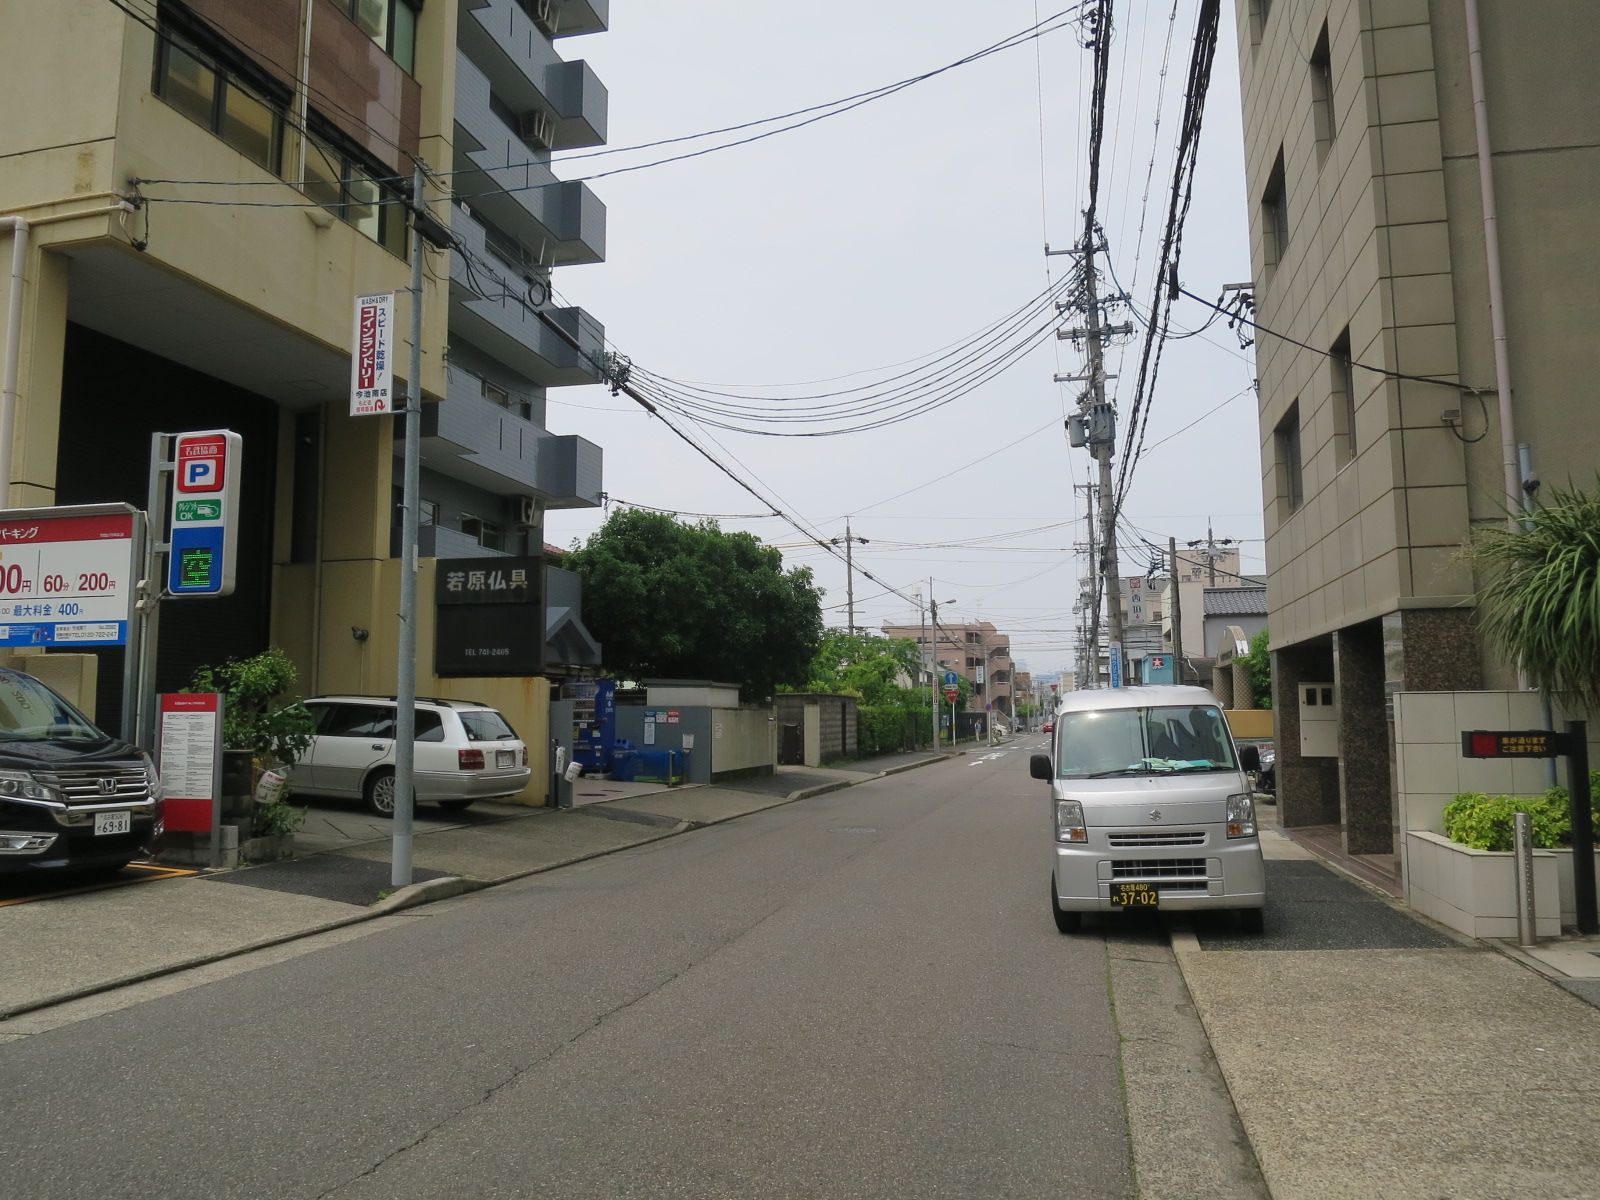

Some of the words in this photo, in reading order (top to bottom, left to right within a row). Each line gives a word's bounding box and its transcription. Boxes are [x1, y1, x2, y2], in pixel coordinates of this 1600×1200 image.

[361, 307, 375, 387] コインランドリー
[189, 463, 210, 483] P
[180, 512, 194, 520] OK
[446, 569, 528, 591] 若原仏具
[1120, 892, 1157, 905] 37-02
